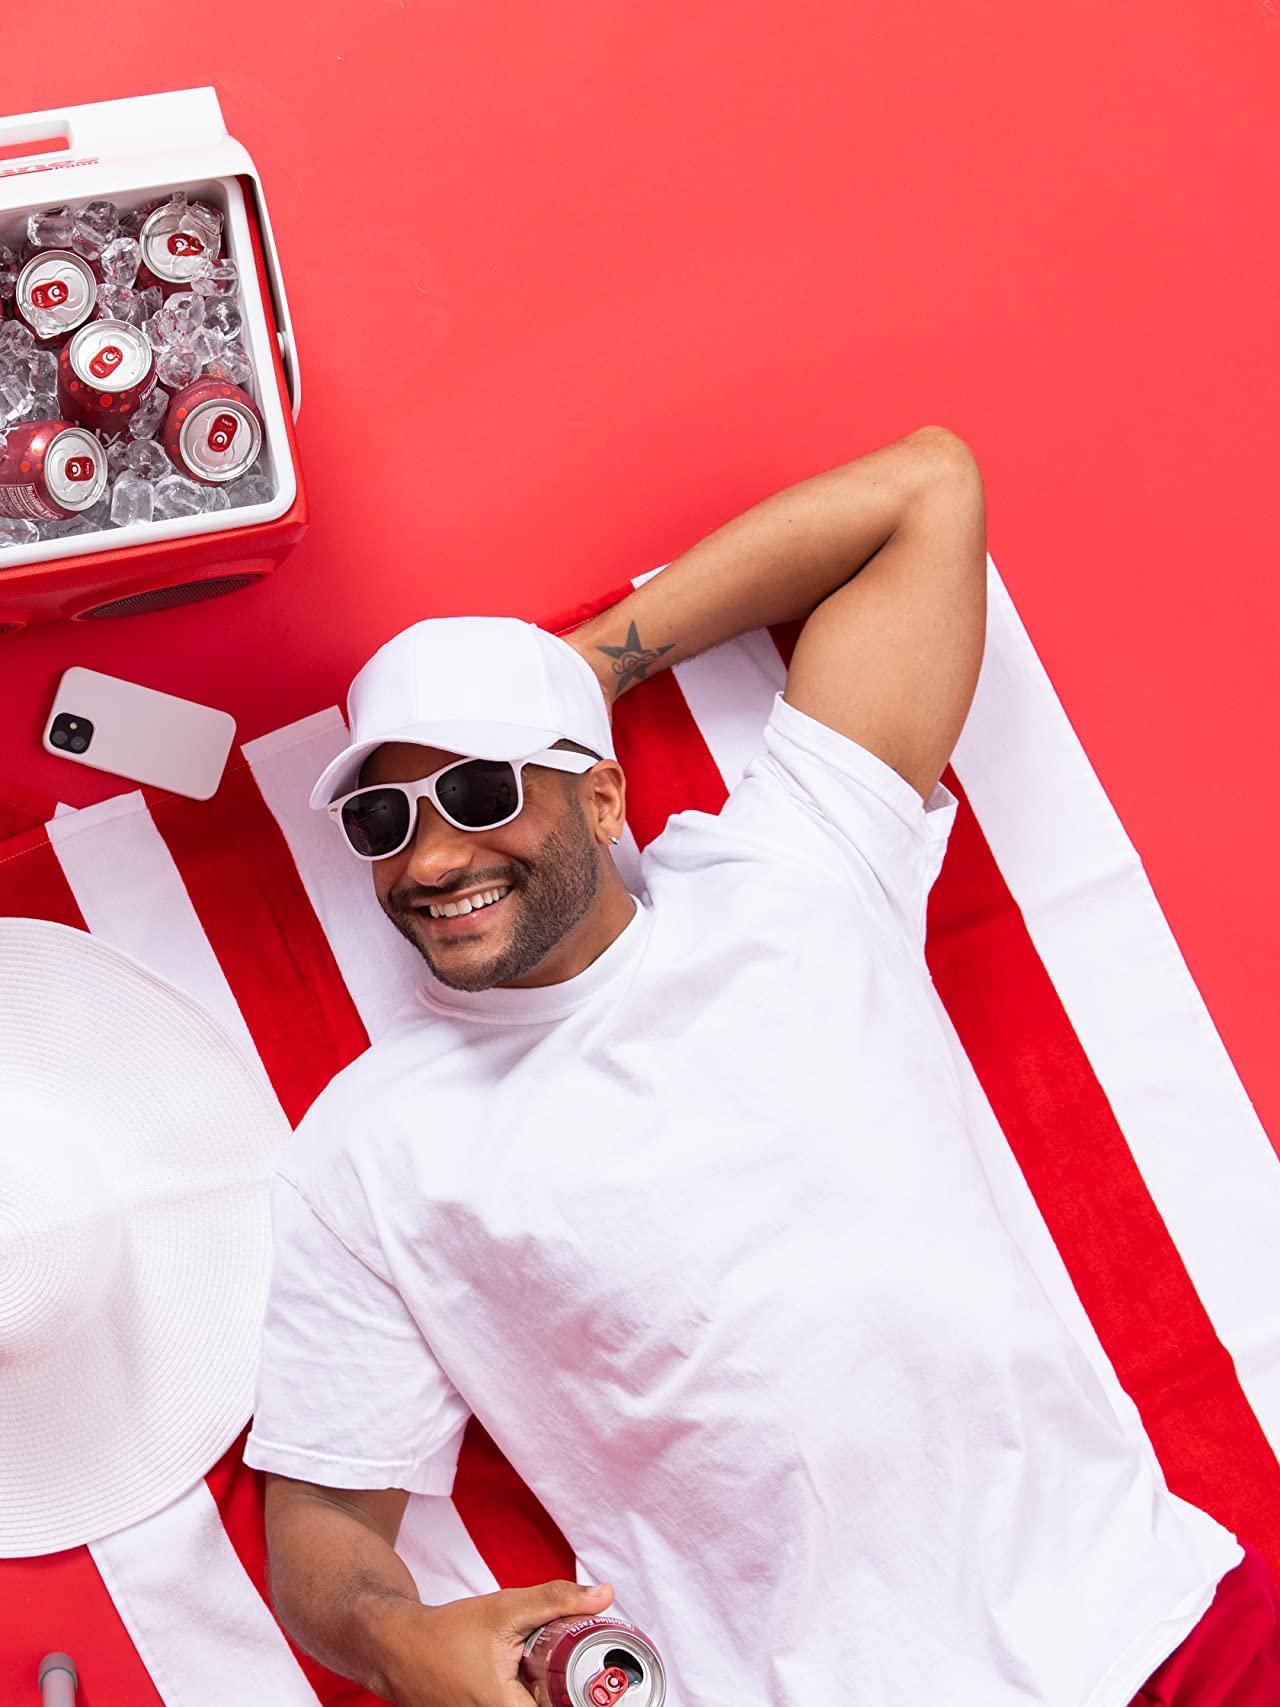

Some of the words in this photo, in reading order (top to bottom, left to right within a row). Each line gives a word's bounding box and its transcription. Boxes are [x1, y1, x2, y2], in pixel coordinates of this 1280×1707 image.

[26, 485, 45, 514] Nutrition
[570, 1619, 595, 1633] Facts
[594, 1617, 632, 1629] Nutrition
